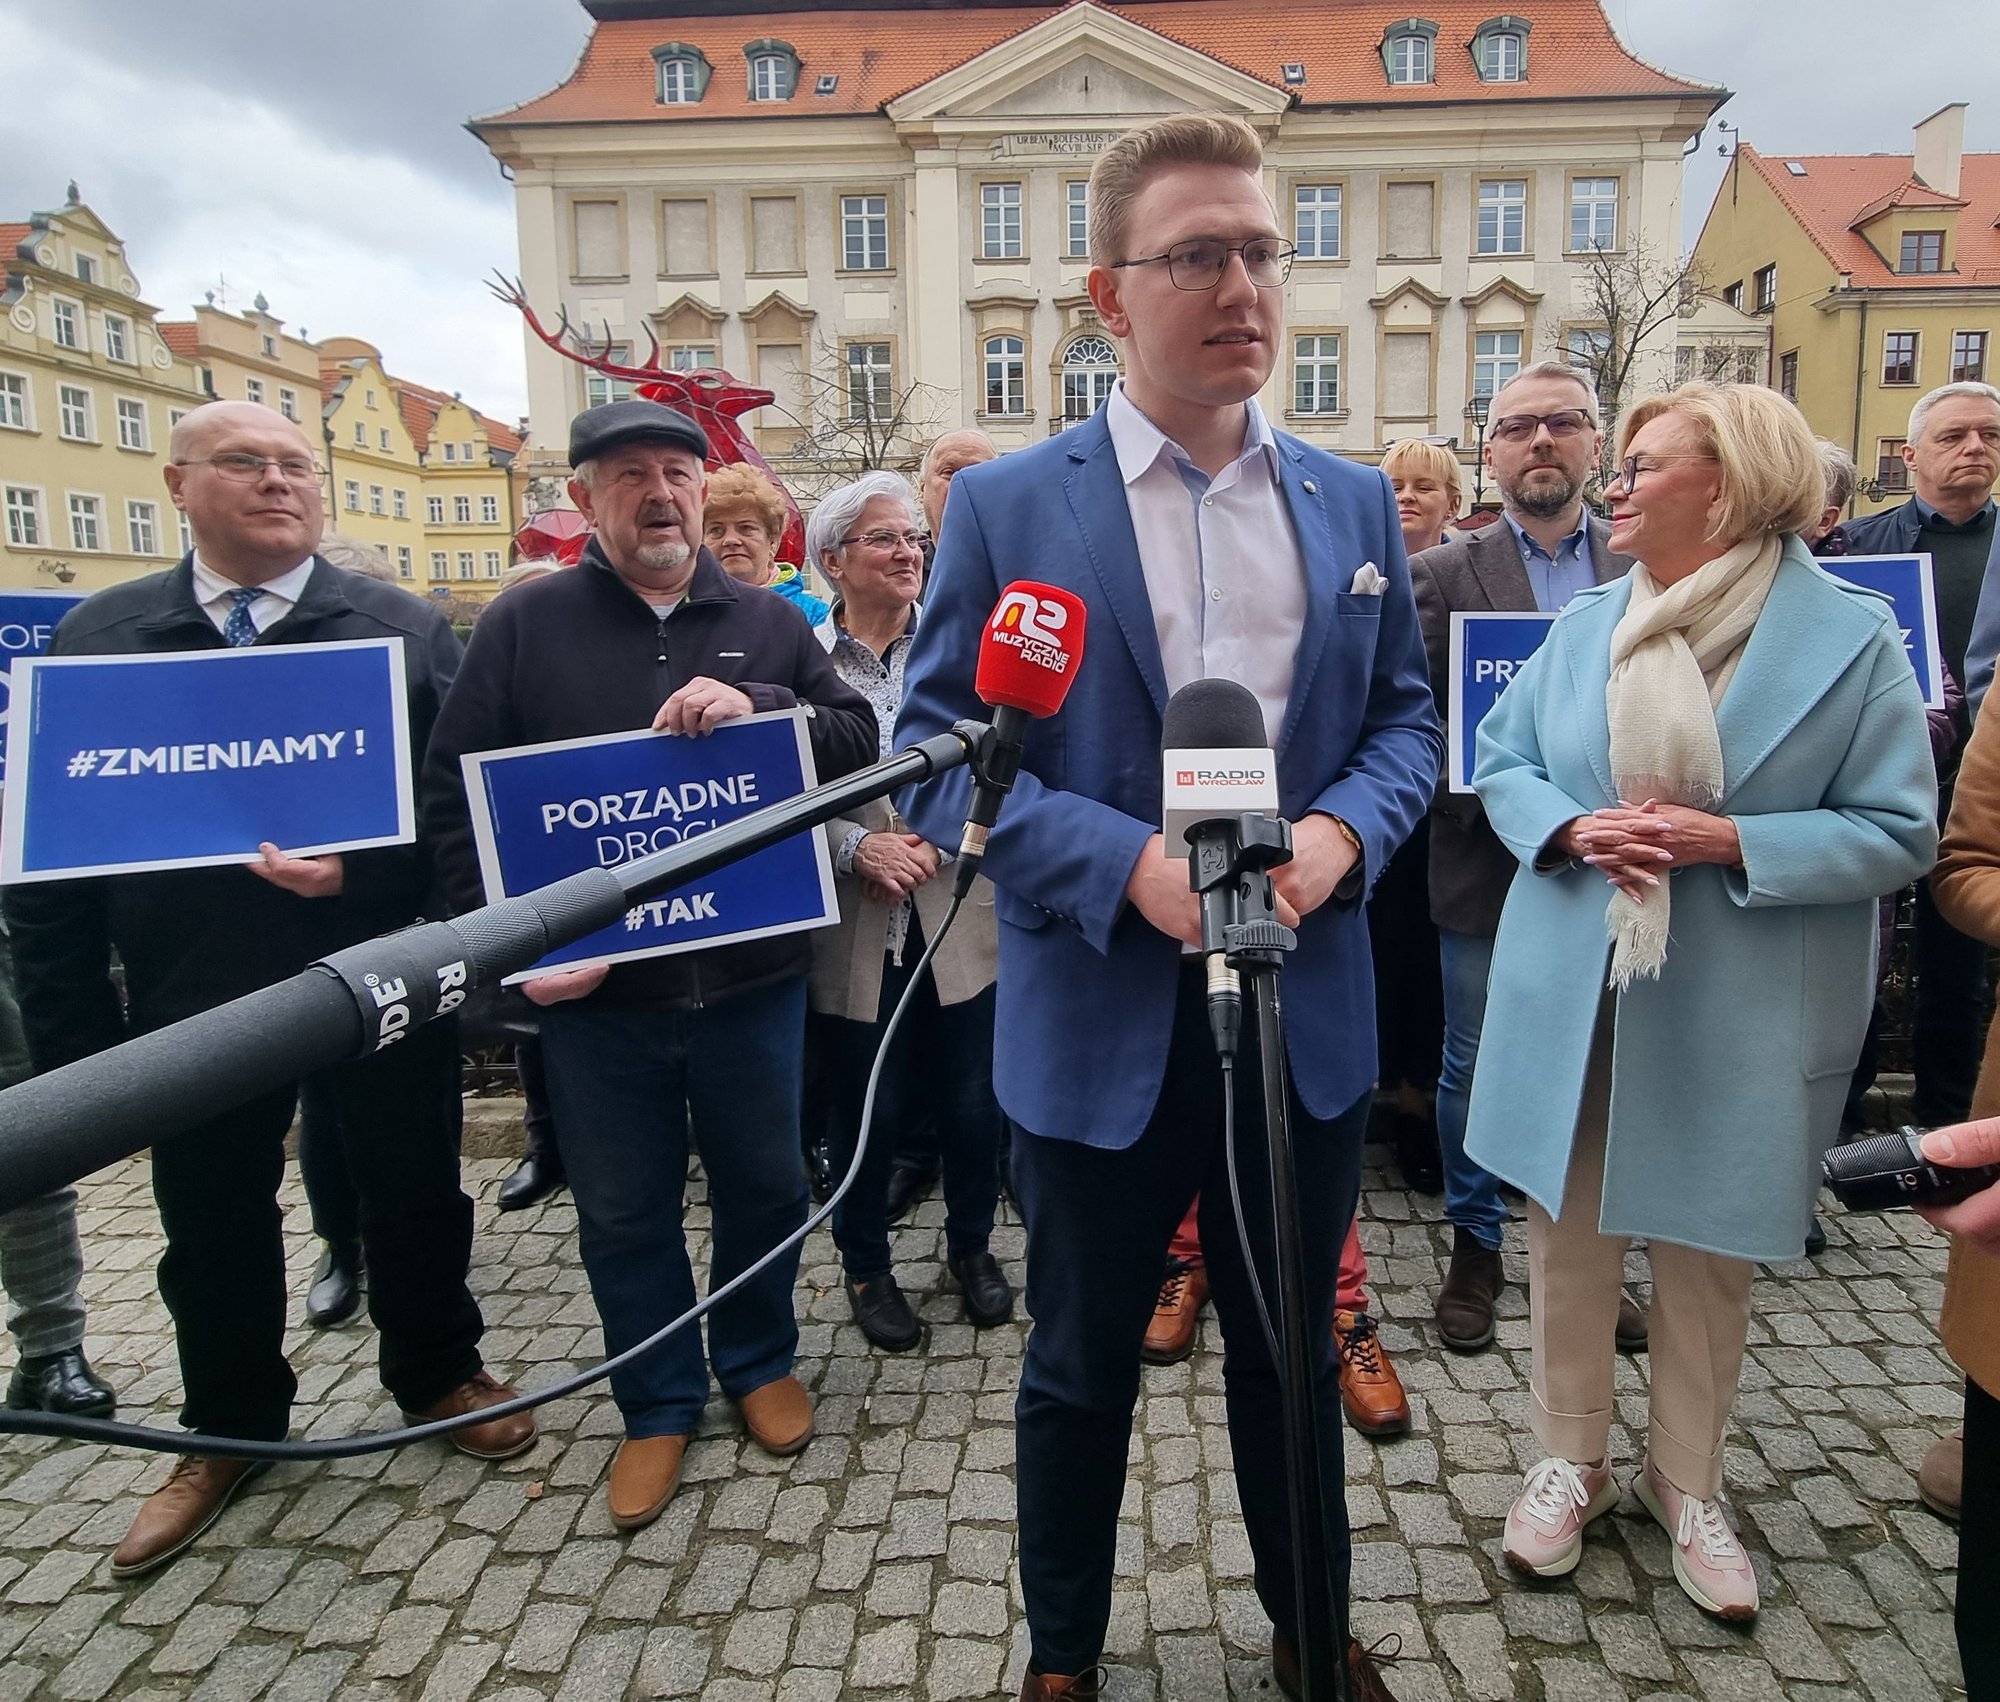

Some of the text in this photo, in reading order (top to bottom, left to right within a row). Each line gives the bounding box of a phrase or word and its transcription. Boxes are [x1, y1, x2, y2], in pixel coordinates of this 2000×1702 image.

[1016, 135, 1048, 145] URBEM
[1053, 133, 1103, 144] BOLESLAUS
[992, 631, 1070, 664] MUZYCZNE
[1020, 648, 1065, 674] RADIO
[67, 730, 345, 778] #ZMIENIAMY
[1198, 770, 1265, 779] RADIO
[541, 773, 760, 834] PORZĄDNE
[625, 891, 720, 933] #TAK
